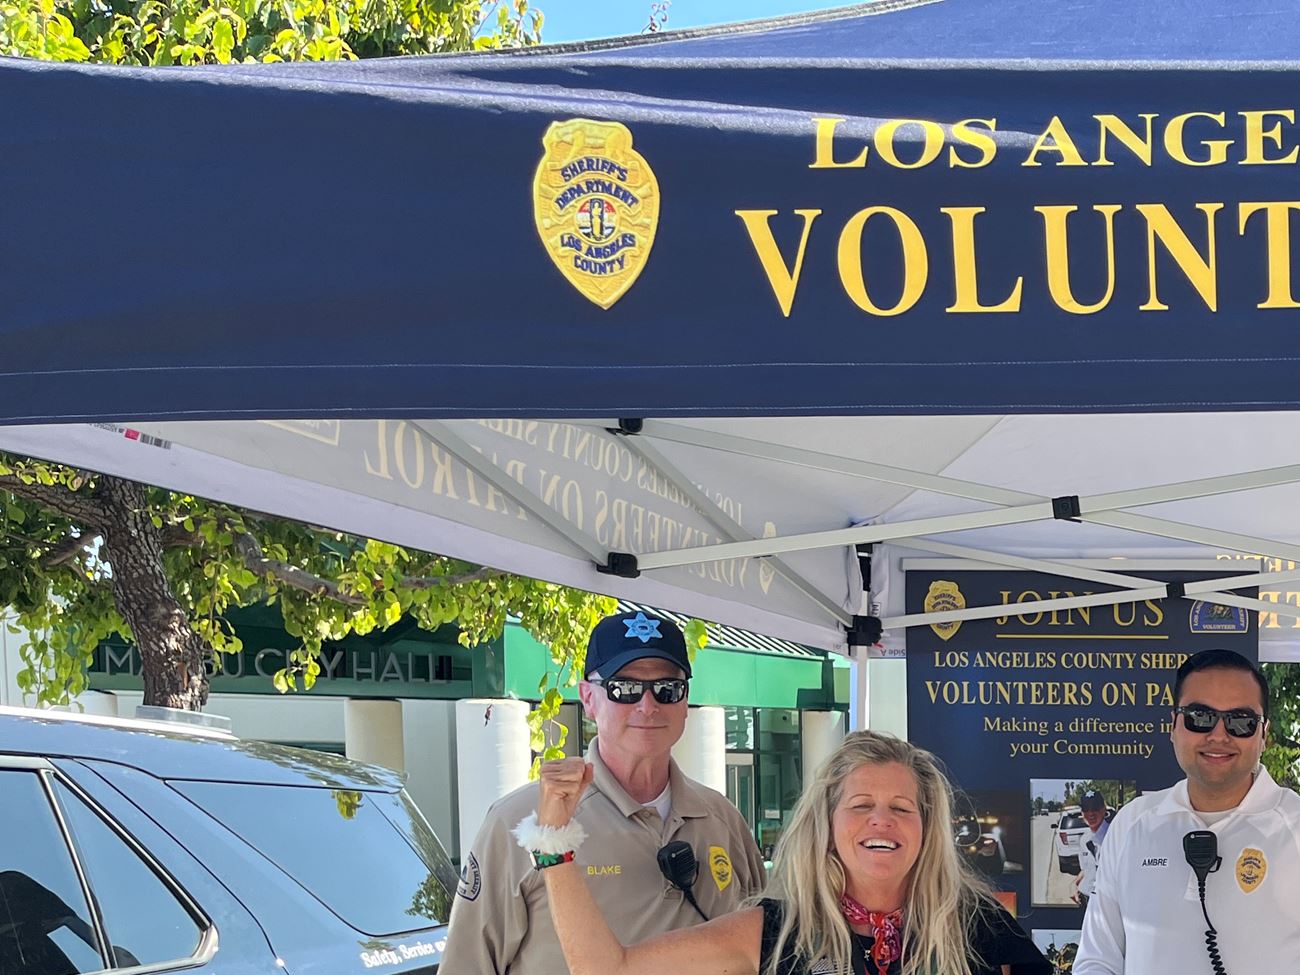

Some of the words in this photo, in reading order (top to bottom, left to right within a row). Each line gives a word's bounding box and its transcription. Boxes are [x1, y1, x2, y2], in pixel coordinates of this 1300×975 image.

[808, 115, 997, 171] LOS
[560, 157, 628, 183] SHERIFF'S
[555, 179, 639, 210] DEPARTMENT
[560, 234, 582, 252] LOS
[585, 233, 636, 259] ANGELES
[574, 255, 625, 275] COUNTY
[997, 589, 1090, 627] JOIN
[1111, 596, 1165, 627] US
[352, 650, 449, 684] HALL
[934, 651, 969, 668] LOS
[973, 651, 1057, 669] ANGELES
[1061, 652, 1136, 669] COUNTY
[925, 680, 1093, 706] VOLUNTEERS
[1101, 682, 1136, 706] ON
[983, 716, 1049, 737] Making
[1054, 721, 1064, 733] a
[1068, 717, 1155, 733] difference
[1010, 741, 1049, 757] your
[1053, 740, 1154, 758] Community
[587, 865, 622, 875] BLAKE
[1142, 858, 1168, 867] AMBRE
[361, 948, 403, 969] Safety,
[398, 941, 435, 960] Service
